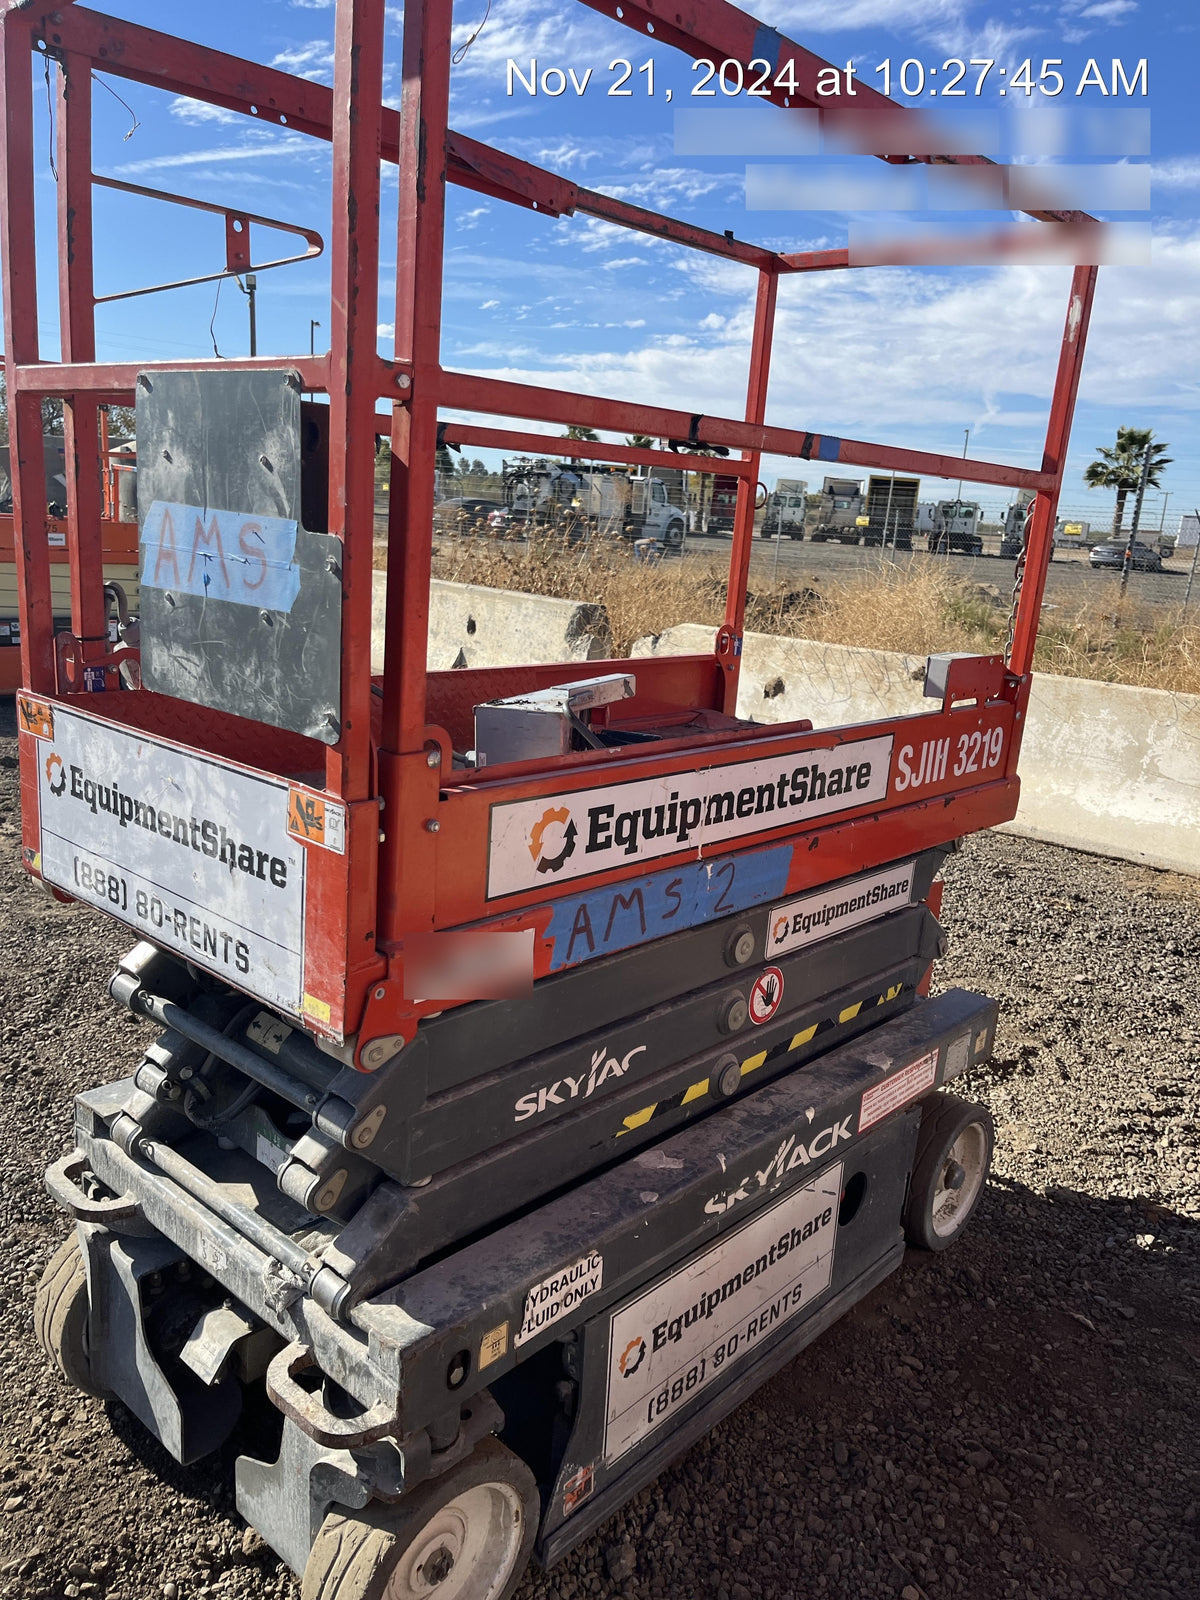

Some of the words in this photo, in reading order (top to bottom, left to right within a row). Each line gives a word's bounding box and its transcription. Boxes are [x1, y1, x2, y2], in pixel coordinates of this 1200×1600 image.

[153, 508, 268, 591] AMS
[953, 726, 1004, 777] 3219
[70, 763, 288, 890] EquipmentShare
[585, 761, 872, 856] EquipmentShare
[74, 856, 128, 911] (888)
[136, 889, 250, 974] 80-RENTS
[566, 878, 683, 961] AMS
[714, 862, 736, 913] 2
[791, 879, 909, 935] EquipmentShare
[526, 1254, 600, 1312] YDRAULIC
[563, 1274, 599, 1309] ONLY
[652, 1206, 832, 1353] EquipmentShare
[647, 1357, 706, 1424] (888)
[713, 1282, 803, 1369] 80-RENTS
